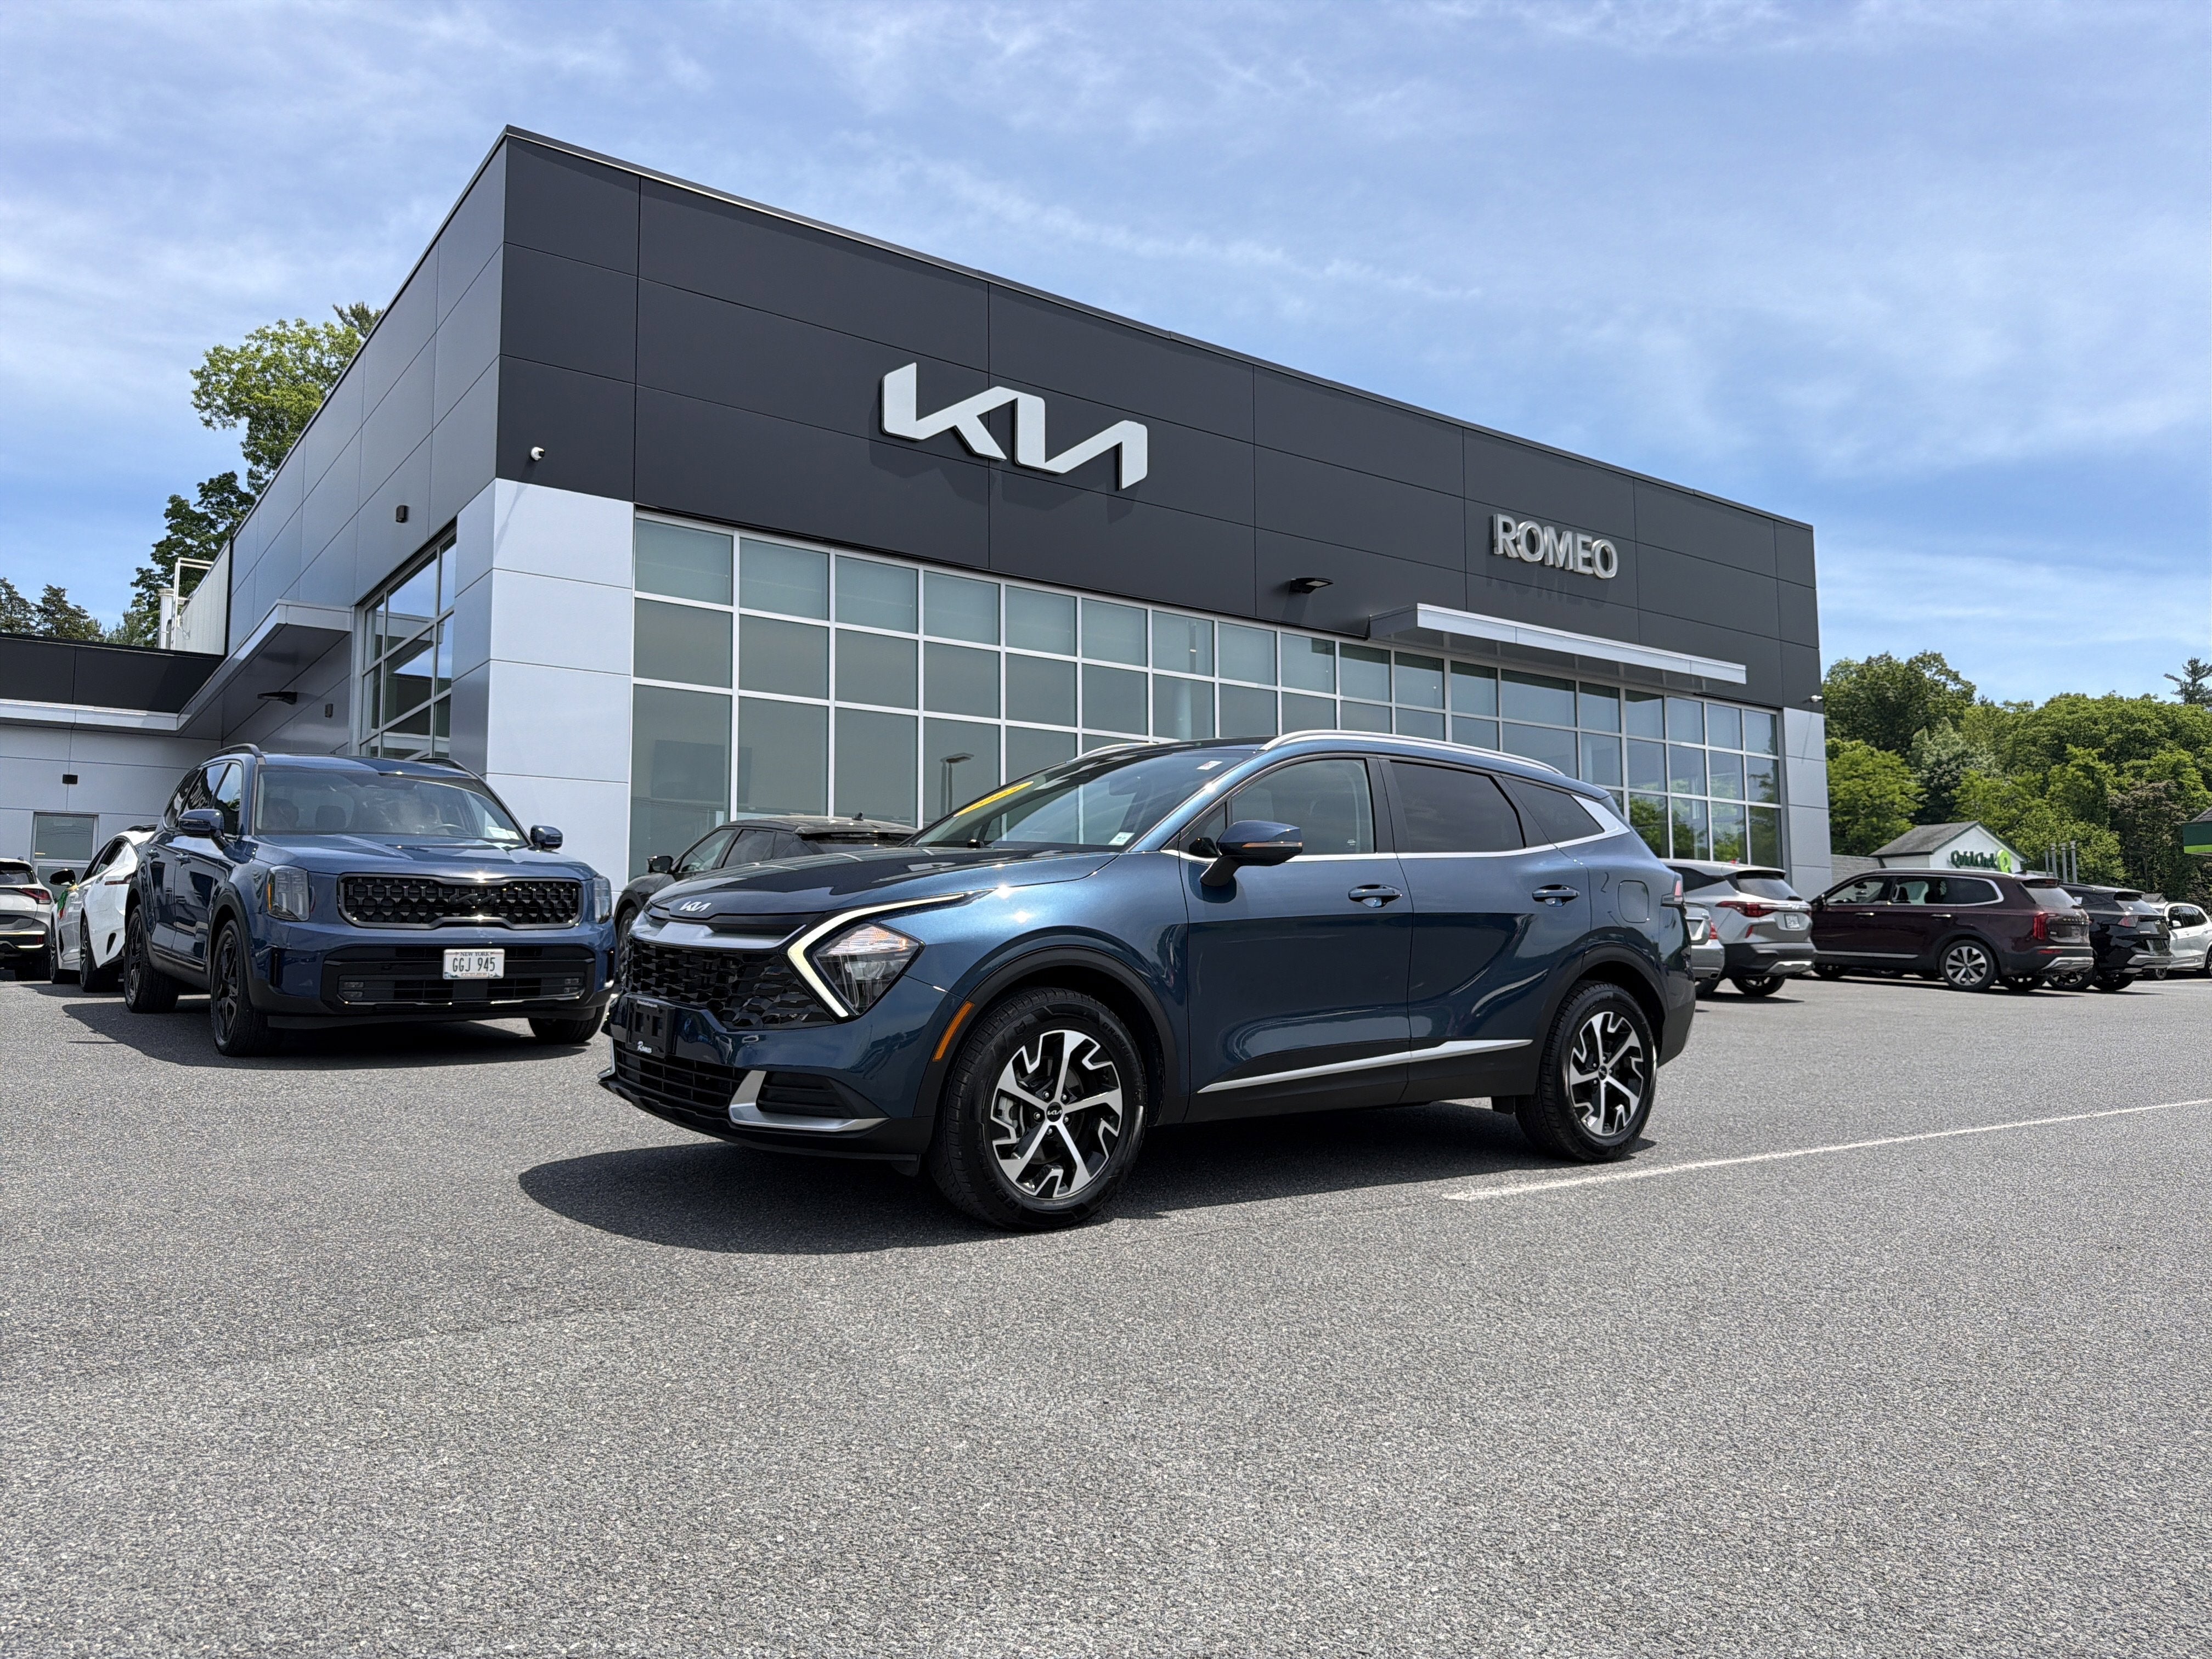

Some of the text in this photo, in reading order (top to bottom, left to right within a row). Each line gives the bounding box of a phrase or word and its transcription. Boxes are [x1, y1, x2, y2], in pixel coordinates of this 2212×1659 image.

[882, 362, 1148, 490] KIA
[1493, 514, 1618, 579] ROMEO
[679, 901, 712, 912] KIA
[453, 957, 496, 972] GGJ 945
